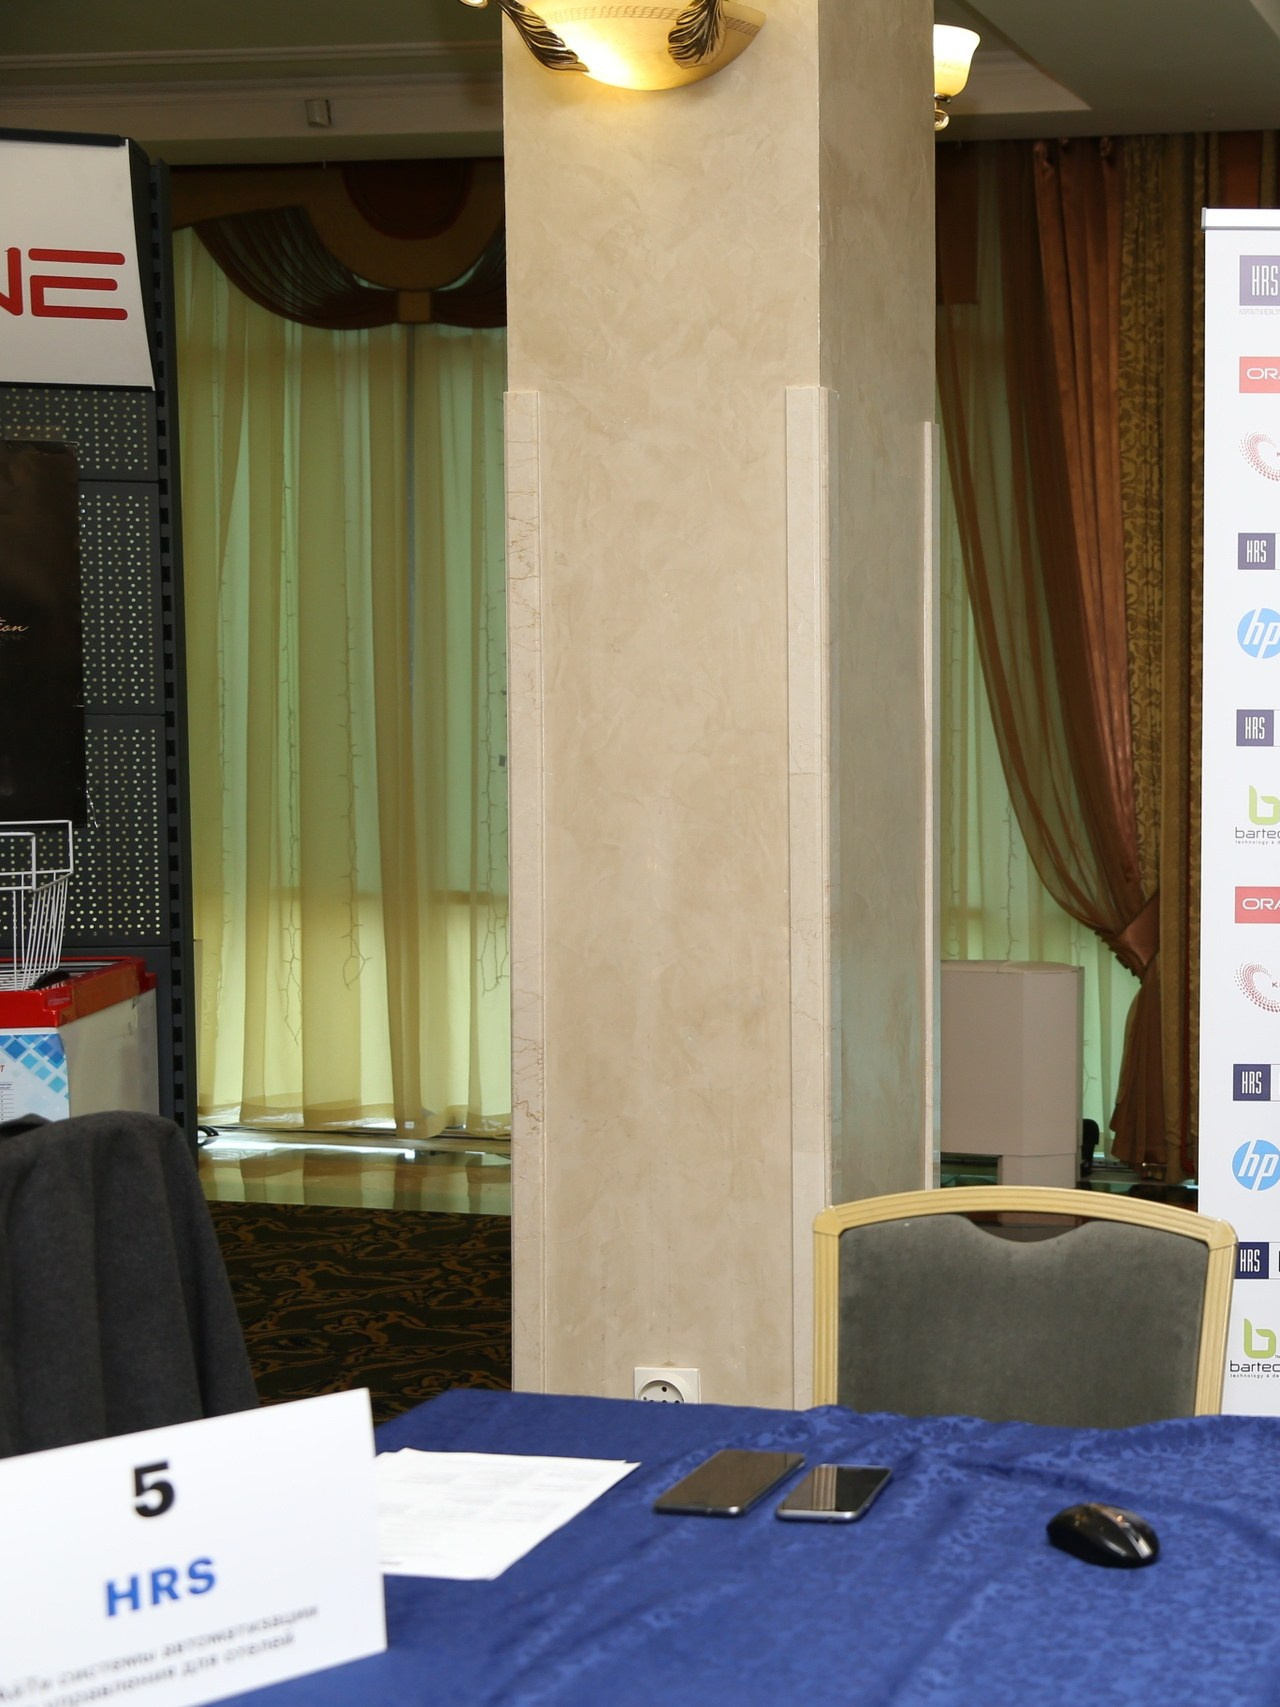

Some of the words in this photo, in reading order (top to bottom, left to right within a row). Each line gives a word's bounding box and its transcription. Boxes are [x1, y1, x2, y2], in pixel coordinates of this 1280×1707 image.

[1252, 265, 1278, 295] HRS
[1247, 540, 1266, 562] HRS
[1243, 608, 1280, 658] hp
[1245, 717, 1265, 739] HRS
[1242, 1071, 1261, 1094] HRS
[1238, 1140, 1278, 1190] hp
[1240, 1249, 1260, 1272] HRS
[134, 1461, 175, 1518] 5
[105, 1557, 216, 1617] HRS
